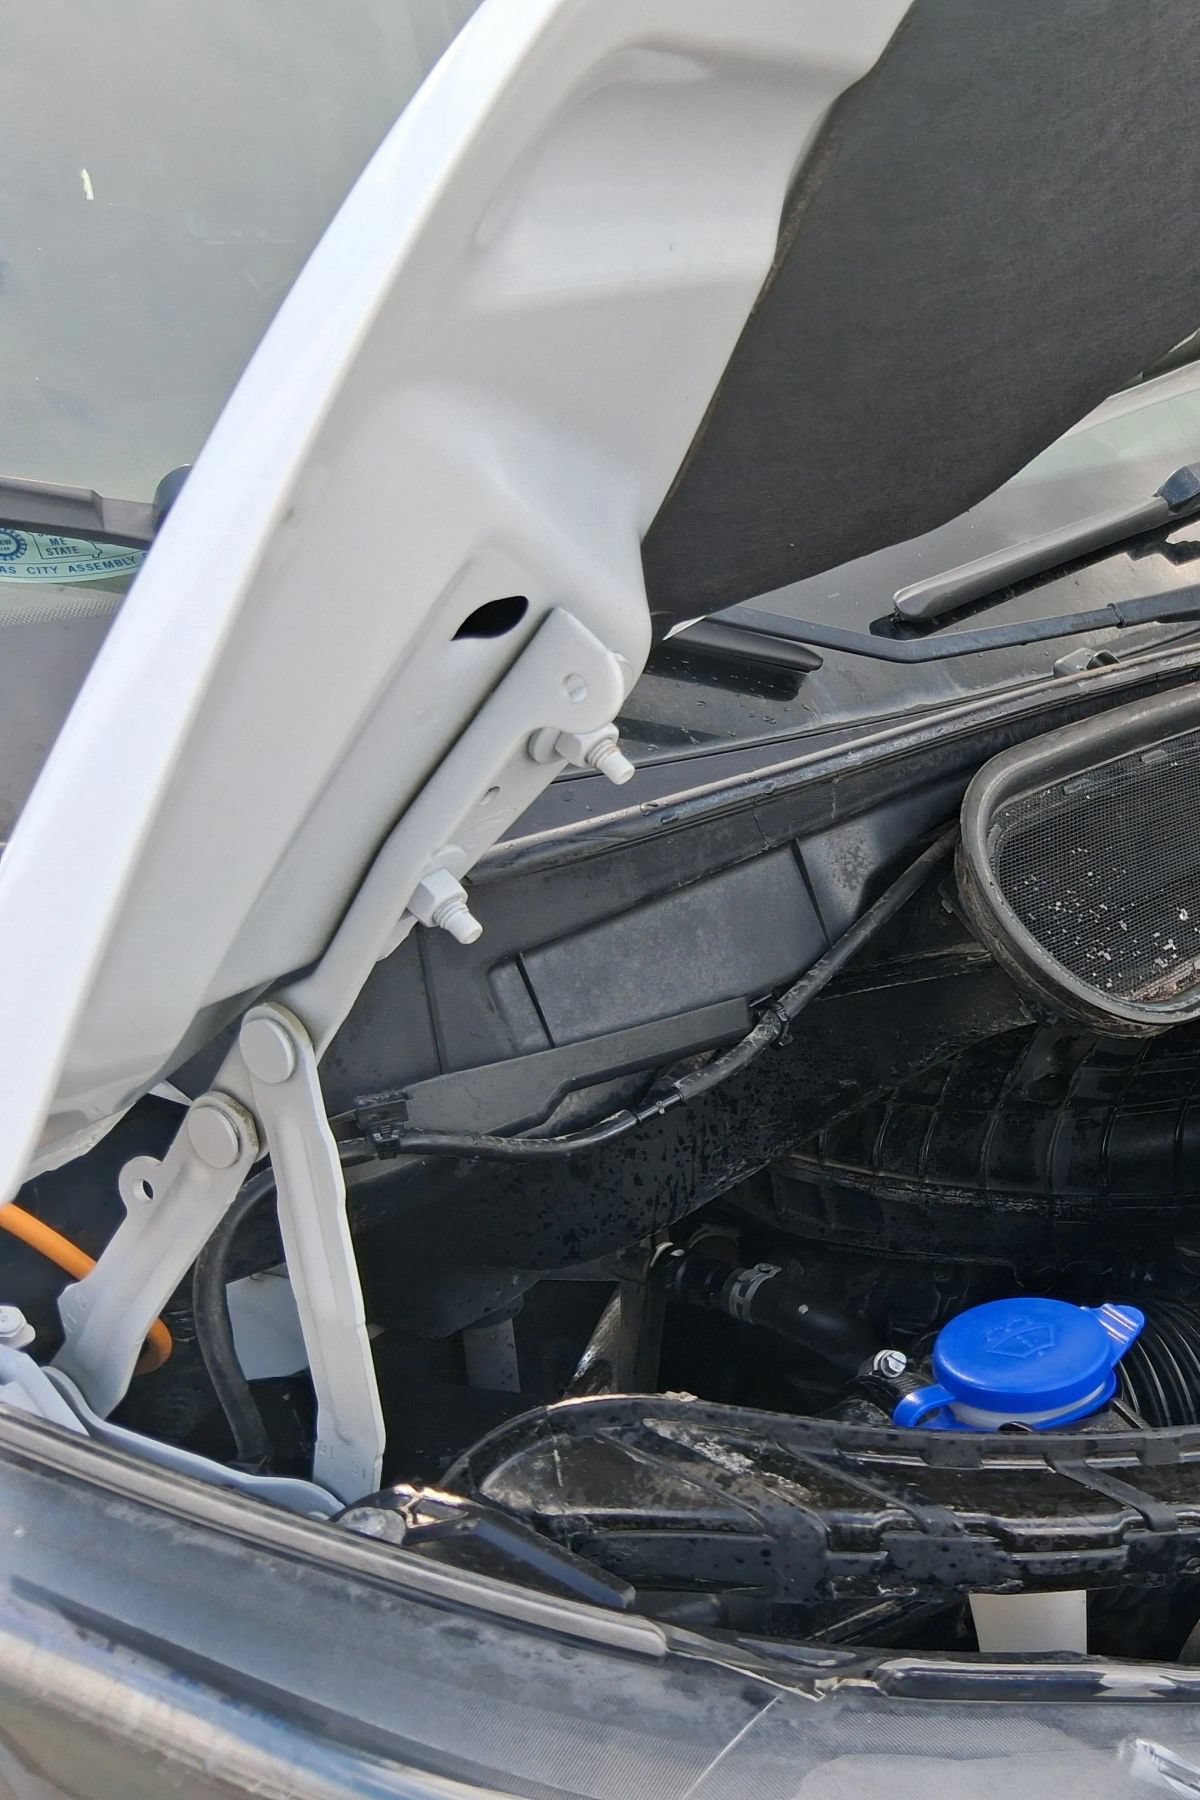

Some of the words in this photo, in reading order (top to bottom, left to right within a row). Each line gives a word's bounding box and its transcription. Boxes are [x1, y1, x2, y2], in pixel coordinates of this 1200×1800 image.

[49, 537, 66, 546] ME
[46, 546, 79, 556] STATE
[26, 566, 58, 575] CITY
[68, 556, 136, 573] ASSEMBLY
